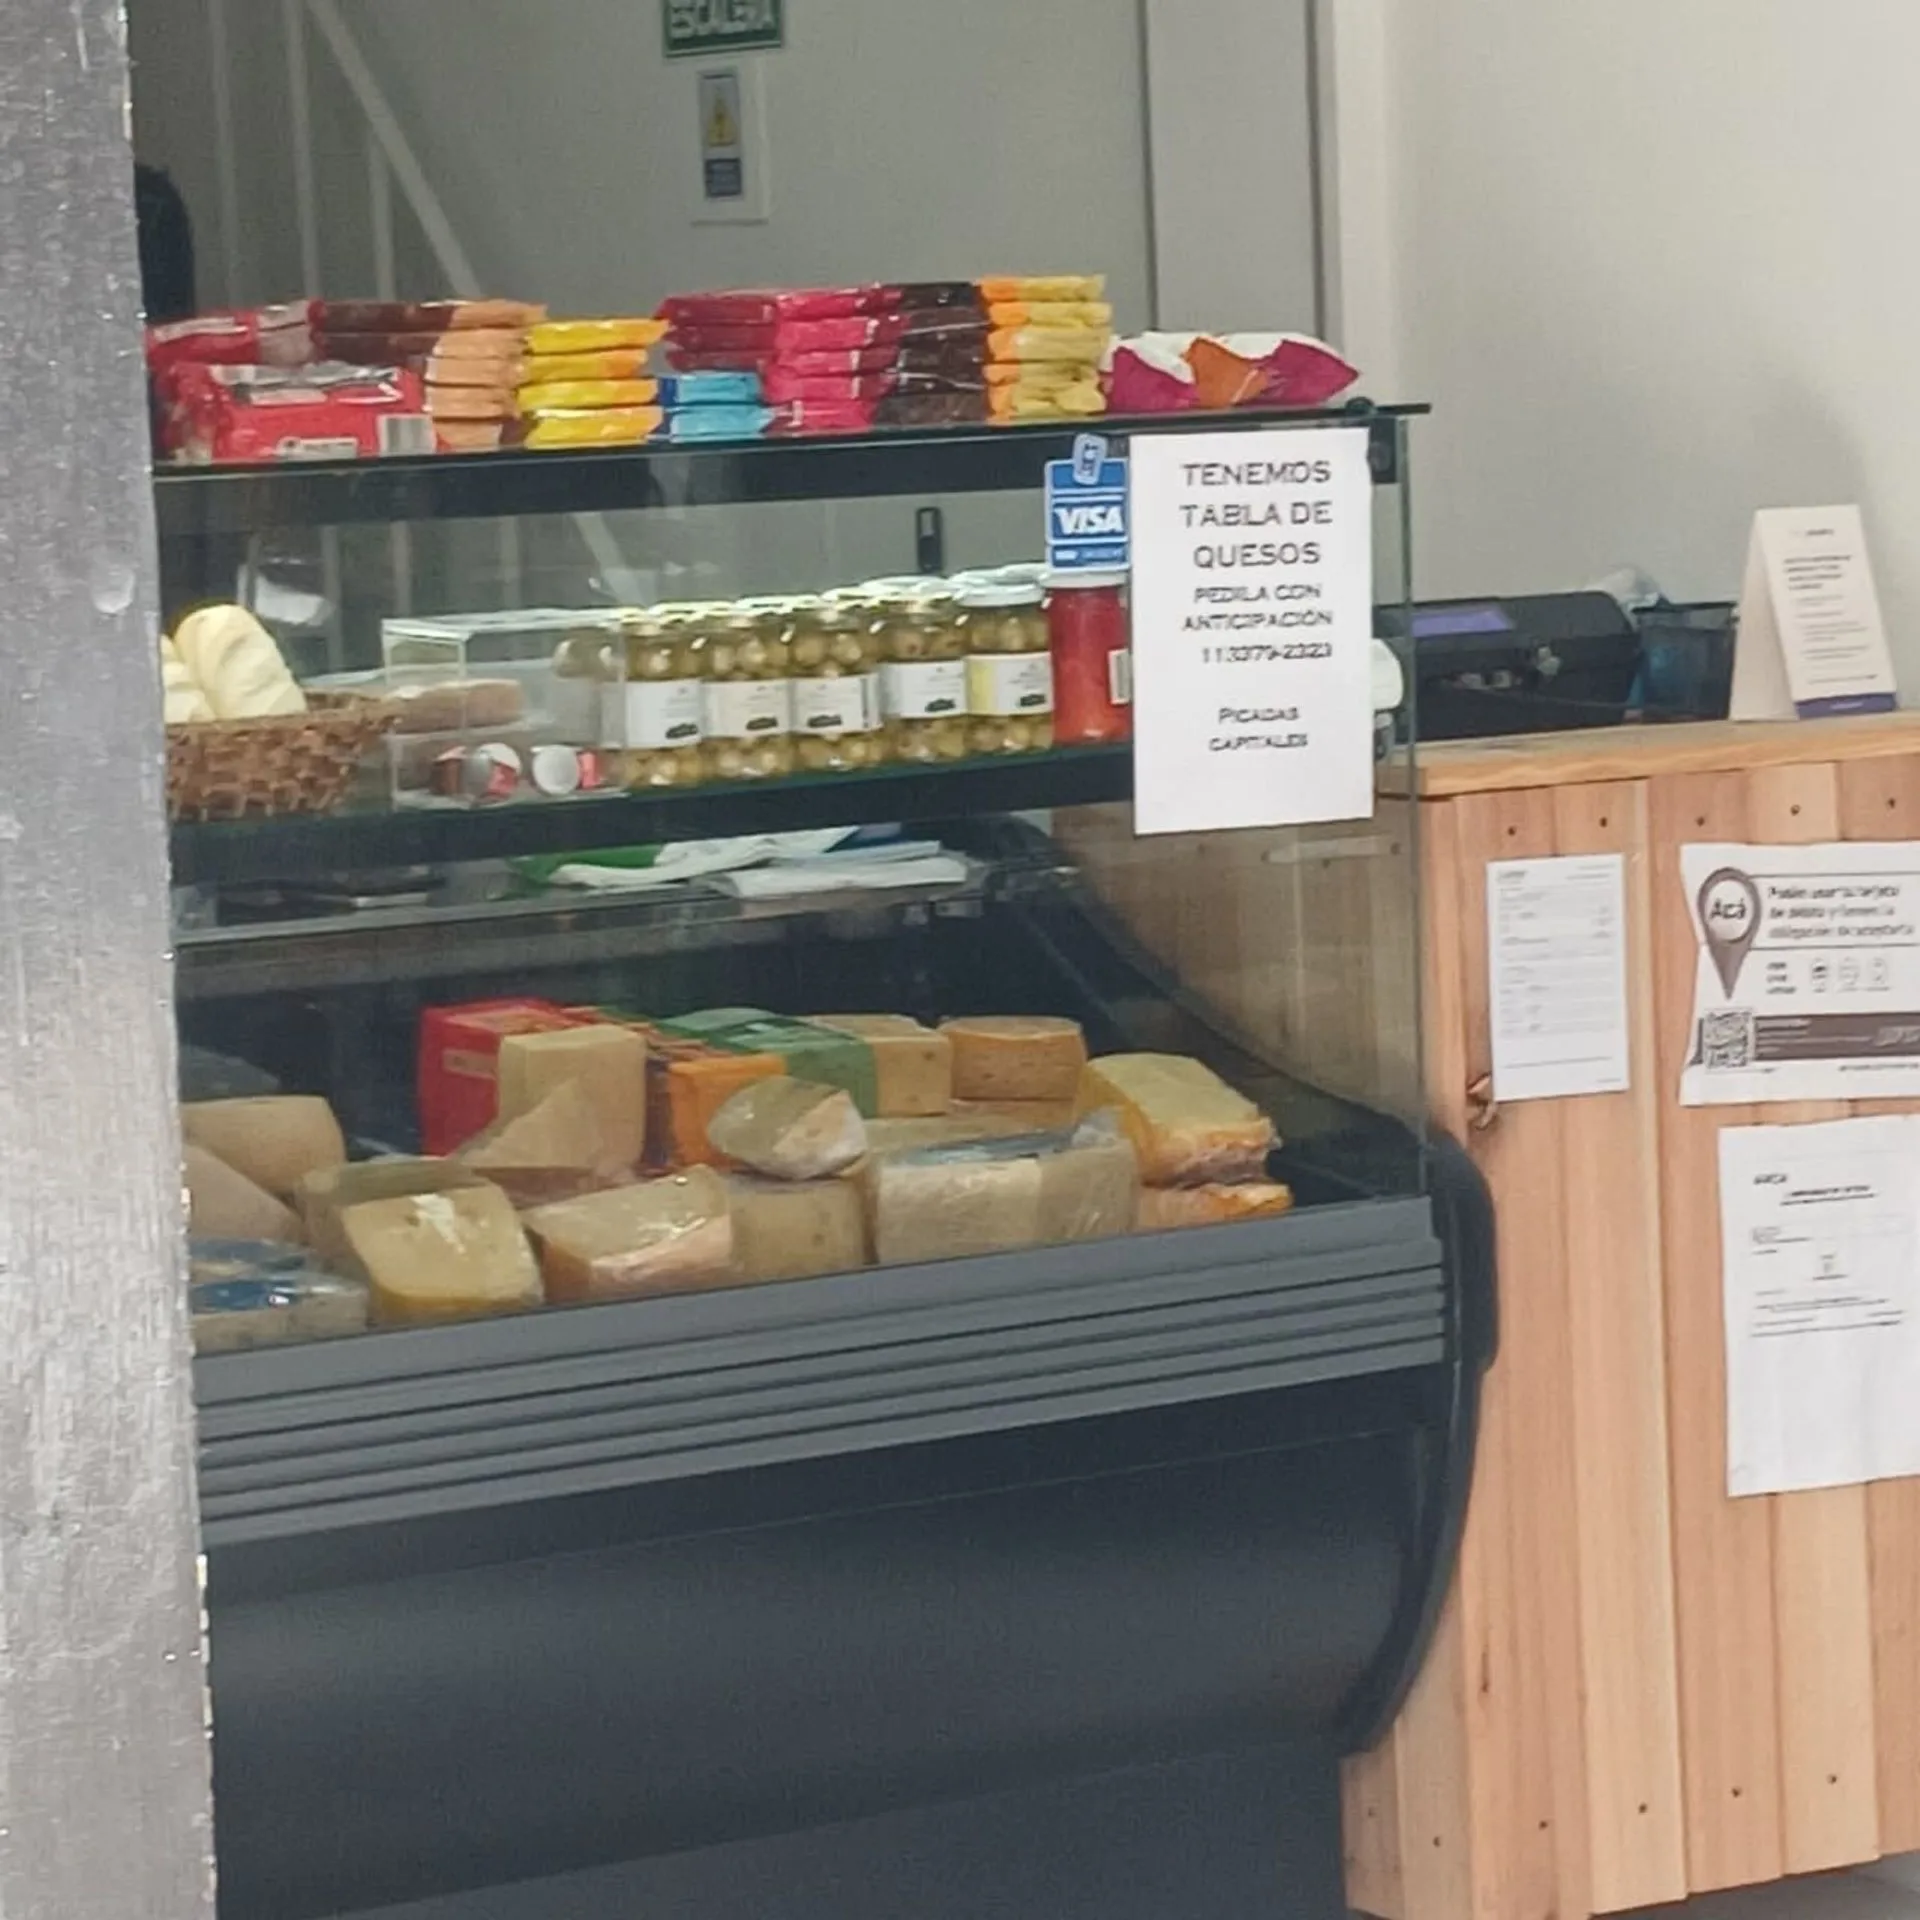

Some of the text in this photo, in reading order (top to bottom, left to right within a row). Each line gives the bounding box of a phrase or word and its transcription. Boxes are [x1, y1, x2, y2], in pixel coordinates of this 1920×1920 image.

[1181, 459, 1332, 486] TENEMOS
[1054, 507, 1125, 537] VISA
[1179, 500, 1333, 528] TABLA DE
[1193, 542, 1321, 569] QUESOS
[1194, 583, 1322, 604] PEDILA CON
[1181, 610, 1333, 632] ANTICIPACIÓN
[1218, 706, 1300, 723] PICADAS
[1209, 732, 1309, 752] CAPITALES
